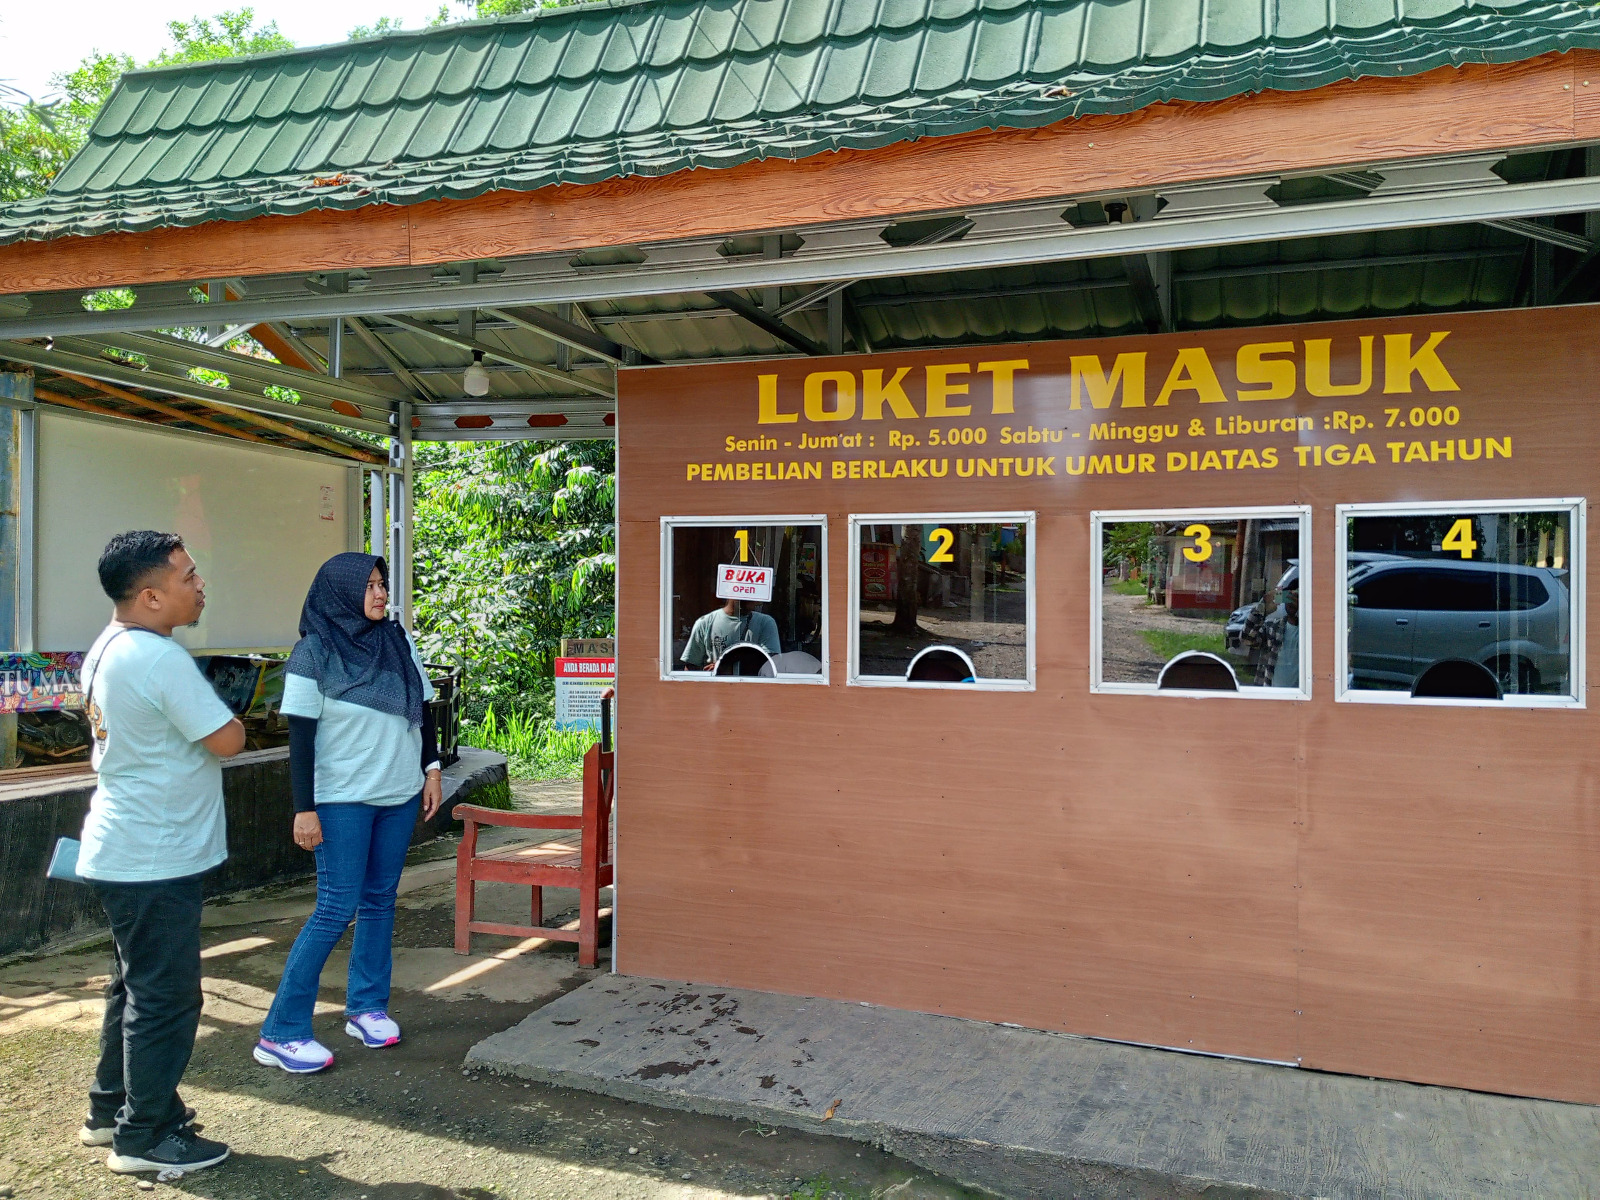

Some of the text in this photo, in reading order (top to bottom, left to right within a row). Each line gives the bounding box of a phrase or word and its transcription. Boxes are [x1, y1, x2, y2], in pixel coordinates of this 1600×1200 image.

[758, 331, 1461, 425] LOKET MASUK
[725, 435, 777, 452] Senin
[798, 432, 863, 450] Jum'at
[889, 430, 921, 451] Rp.
[928, 427, 987, 446] 5.000
[1000, 426, 1063, 445] Sabtu
[1089, 419, 1180, 443] Minggu
[1188, 417, 1206, 436] &
[1216, 414, 1314, 436] Liburan
[1384, 405, 1462, 428] 7.000
[686, 436, 1513, 481] PEMBELIAN BERLAKU UNTUK UMUR DIATAS TIGA TAHUN
[734, 529, 748, 562] 1
[928, 528, 954, 563] 2
[1183, 523, 1213, 563] 3
[1441, 518, 1477, 559] 4
[725, 569, 765, 583] BUKA
[732, 585, 756, 594] OPEN
[600, 662, 607, 673] DI
